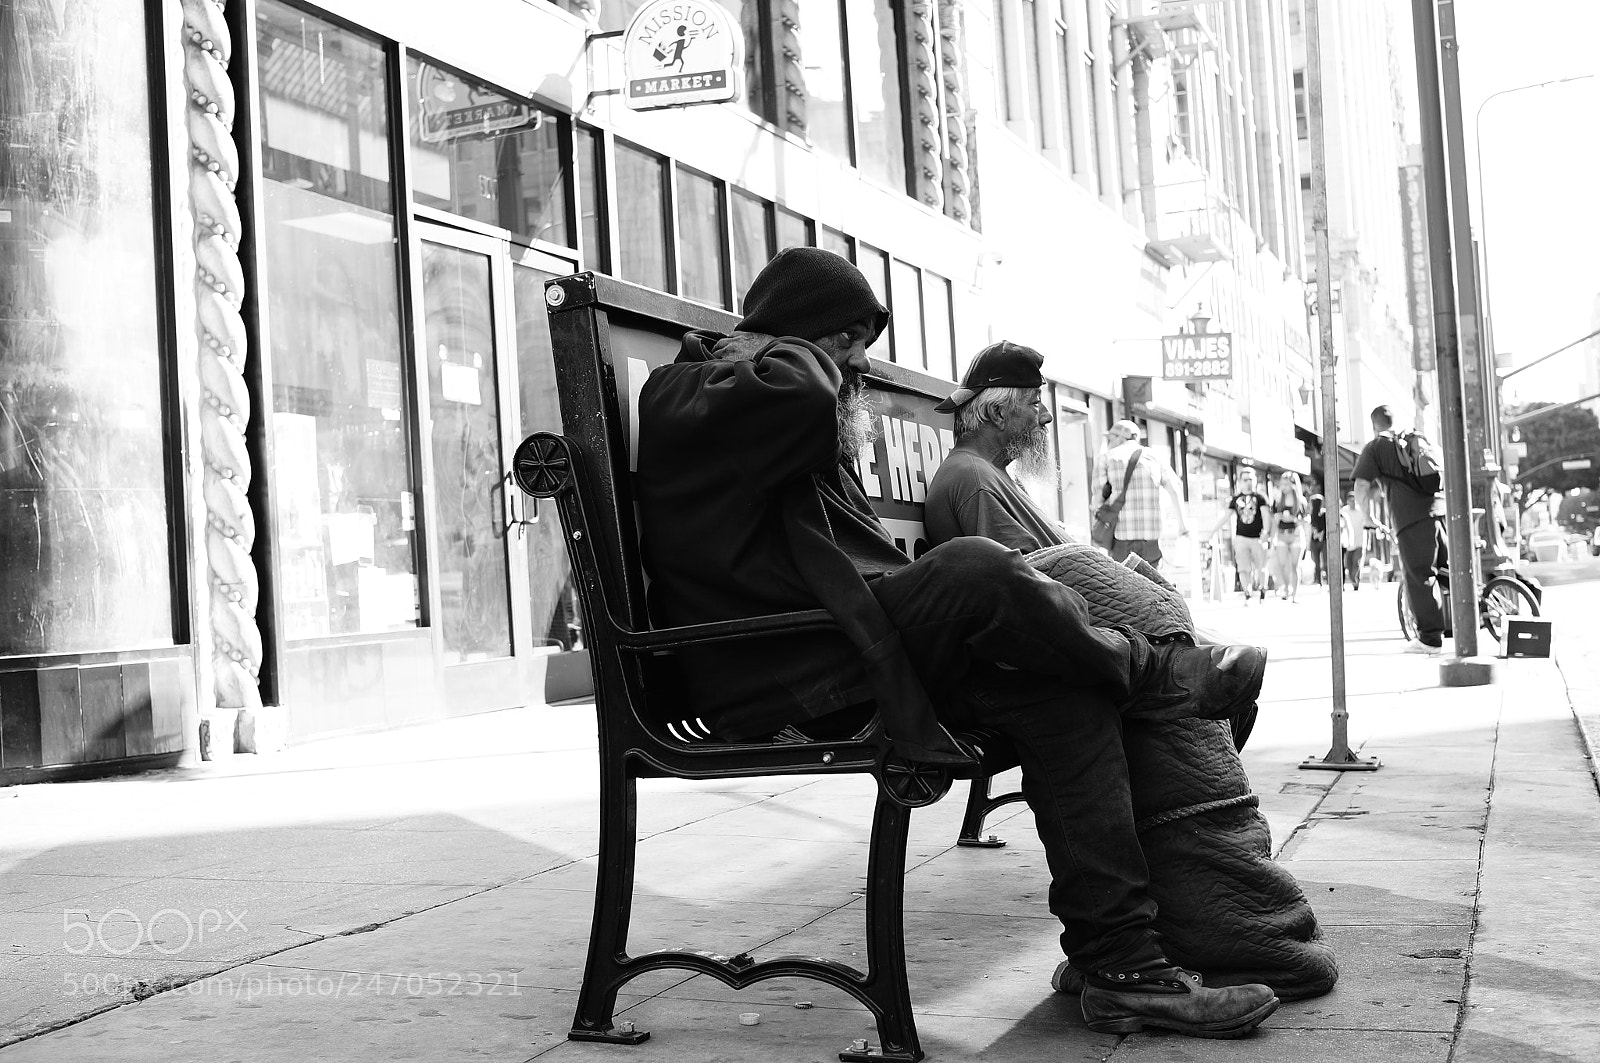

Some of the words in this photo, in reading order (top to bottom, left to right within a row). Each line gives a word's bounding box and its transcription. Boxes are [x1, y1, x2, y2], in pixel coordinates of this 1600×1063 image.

[639, 6, 719, 45] MISSION
[644, 74, 713, 94] MARKET
[1163, 336, 1230, 360] VIAJES
